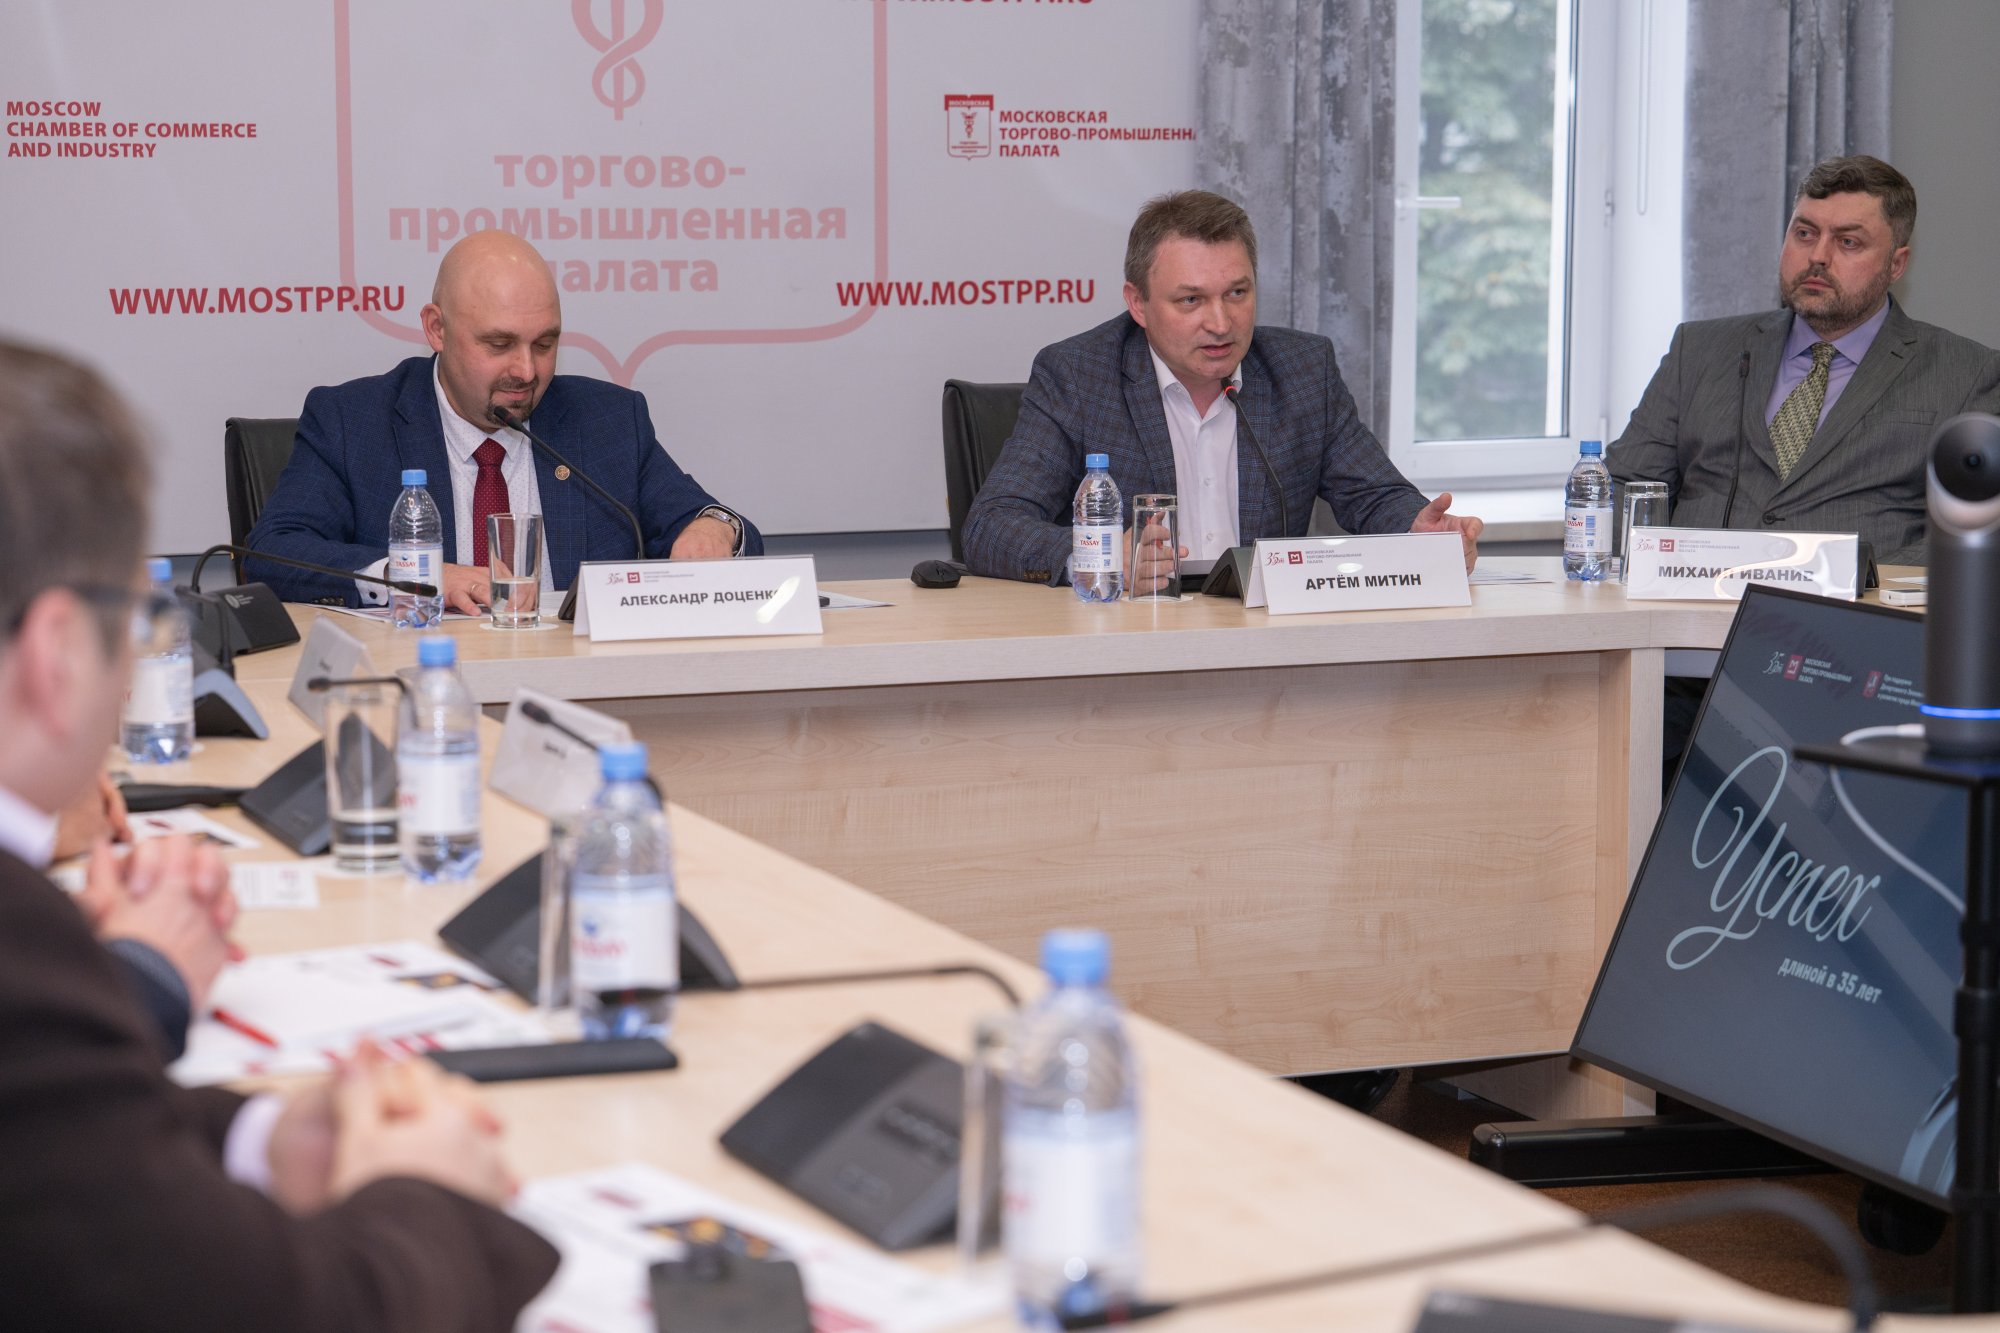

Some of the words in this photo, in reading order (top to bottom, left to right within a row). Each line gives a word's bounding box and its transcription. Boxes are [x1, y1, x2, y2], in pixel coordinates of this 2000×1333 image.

[6, 101, 101, 117] MOSCOW
[999, 110, 1108, 123] МОСКОВСКАЯ
[7, 121, 107, 138] CHAMBER
[112, 122, 139, 138] OF
[144, 122, 257, 138] COMMERCE
[7, 142, 52, 158] AND
[57, 143, 157, 158] INDUSTRY
[999, 145, 1060, 157] ПАЛАТА
[494, 153, 746, 199] торгово-
[389, 206, 847, 252] промышленная
[109, 285, 405, 315] WWW.MOSTPP.RU
[836, 280, 1096, 307] WWW.MOSTPP.RU
[1305, 574, 1360, 590] АРТЁМ
[1364, 574, 1422, 588] МИТИН
[620, 592, 708, 607] АЛЕКСАНДР
[1666, 746, 1881, 970] Успех
[1777, 957, 1828, 986] длиной
[1825, 972, 1837, 989] в
[1836, 971, 1859, 995] 35
[1855, 983, 1882, 1004] лет
